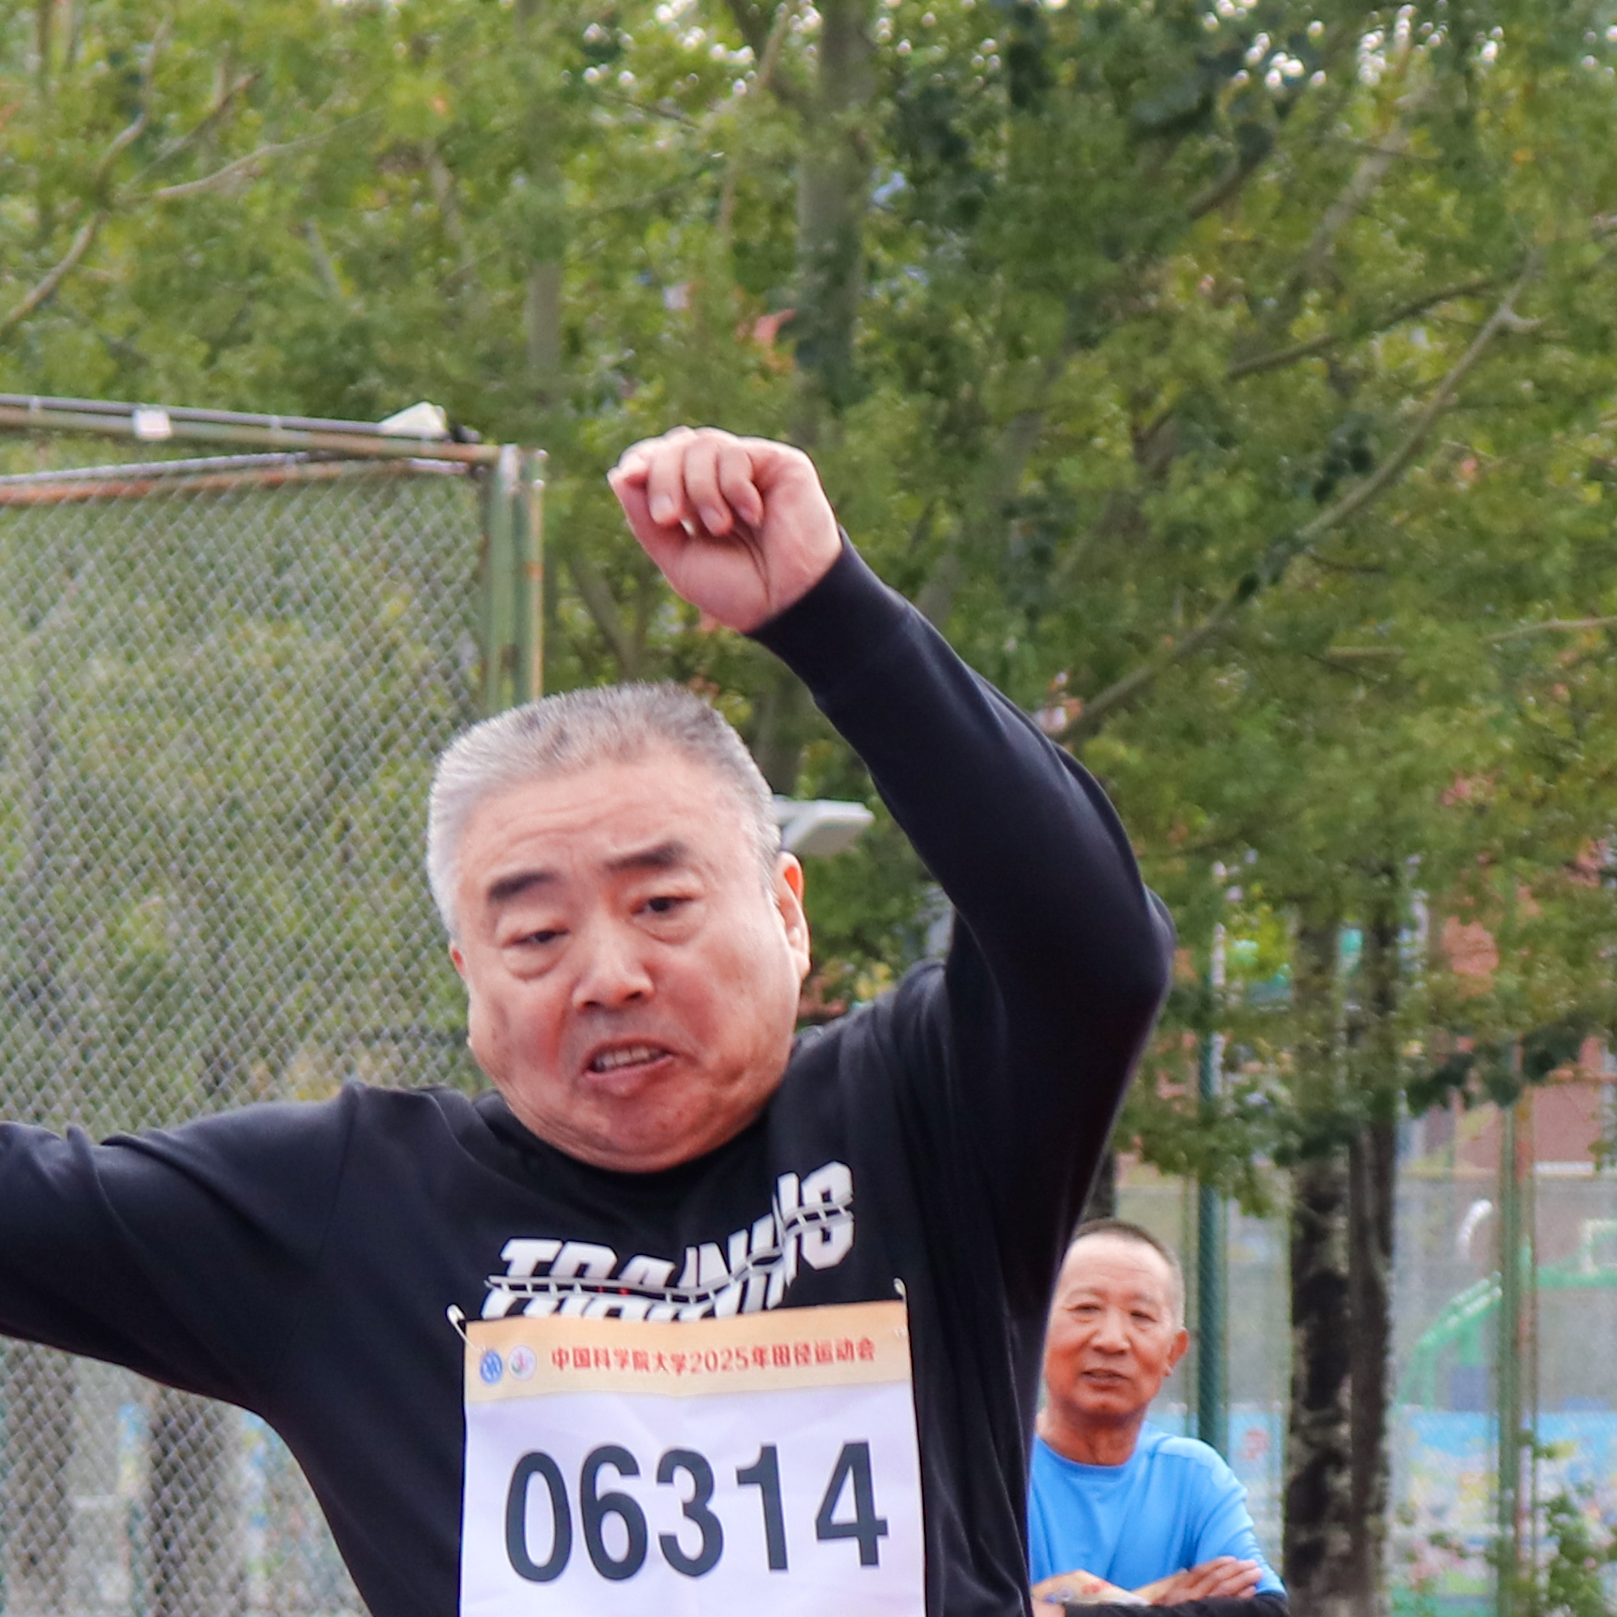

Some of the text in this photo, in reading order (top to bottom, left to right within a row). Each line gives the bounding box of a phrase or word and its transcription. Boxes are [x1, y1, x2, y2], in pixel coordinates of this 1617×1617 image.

[550, 1335, 876, 1377] 中国科学院大学2025年田径运动会
[504, 1438, 888, 1584] 06314
